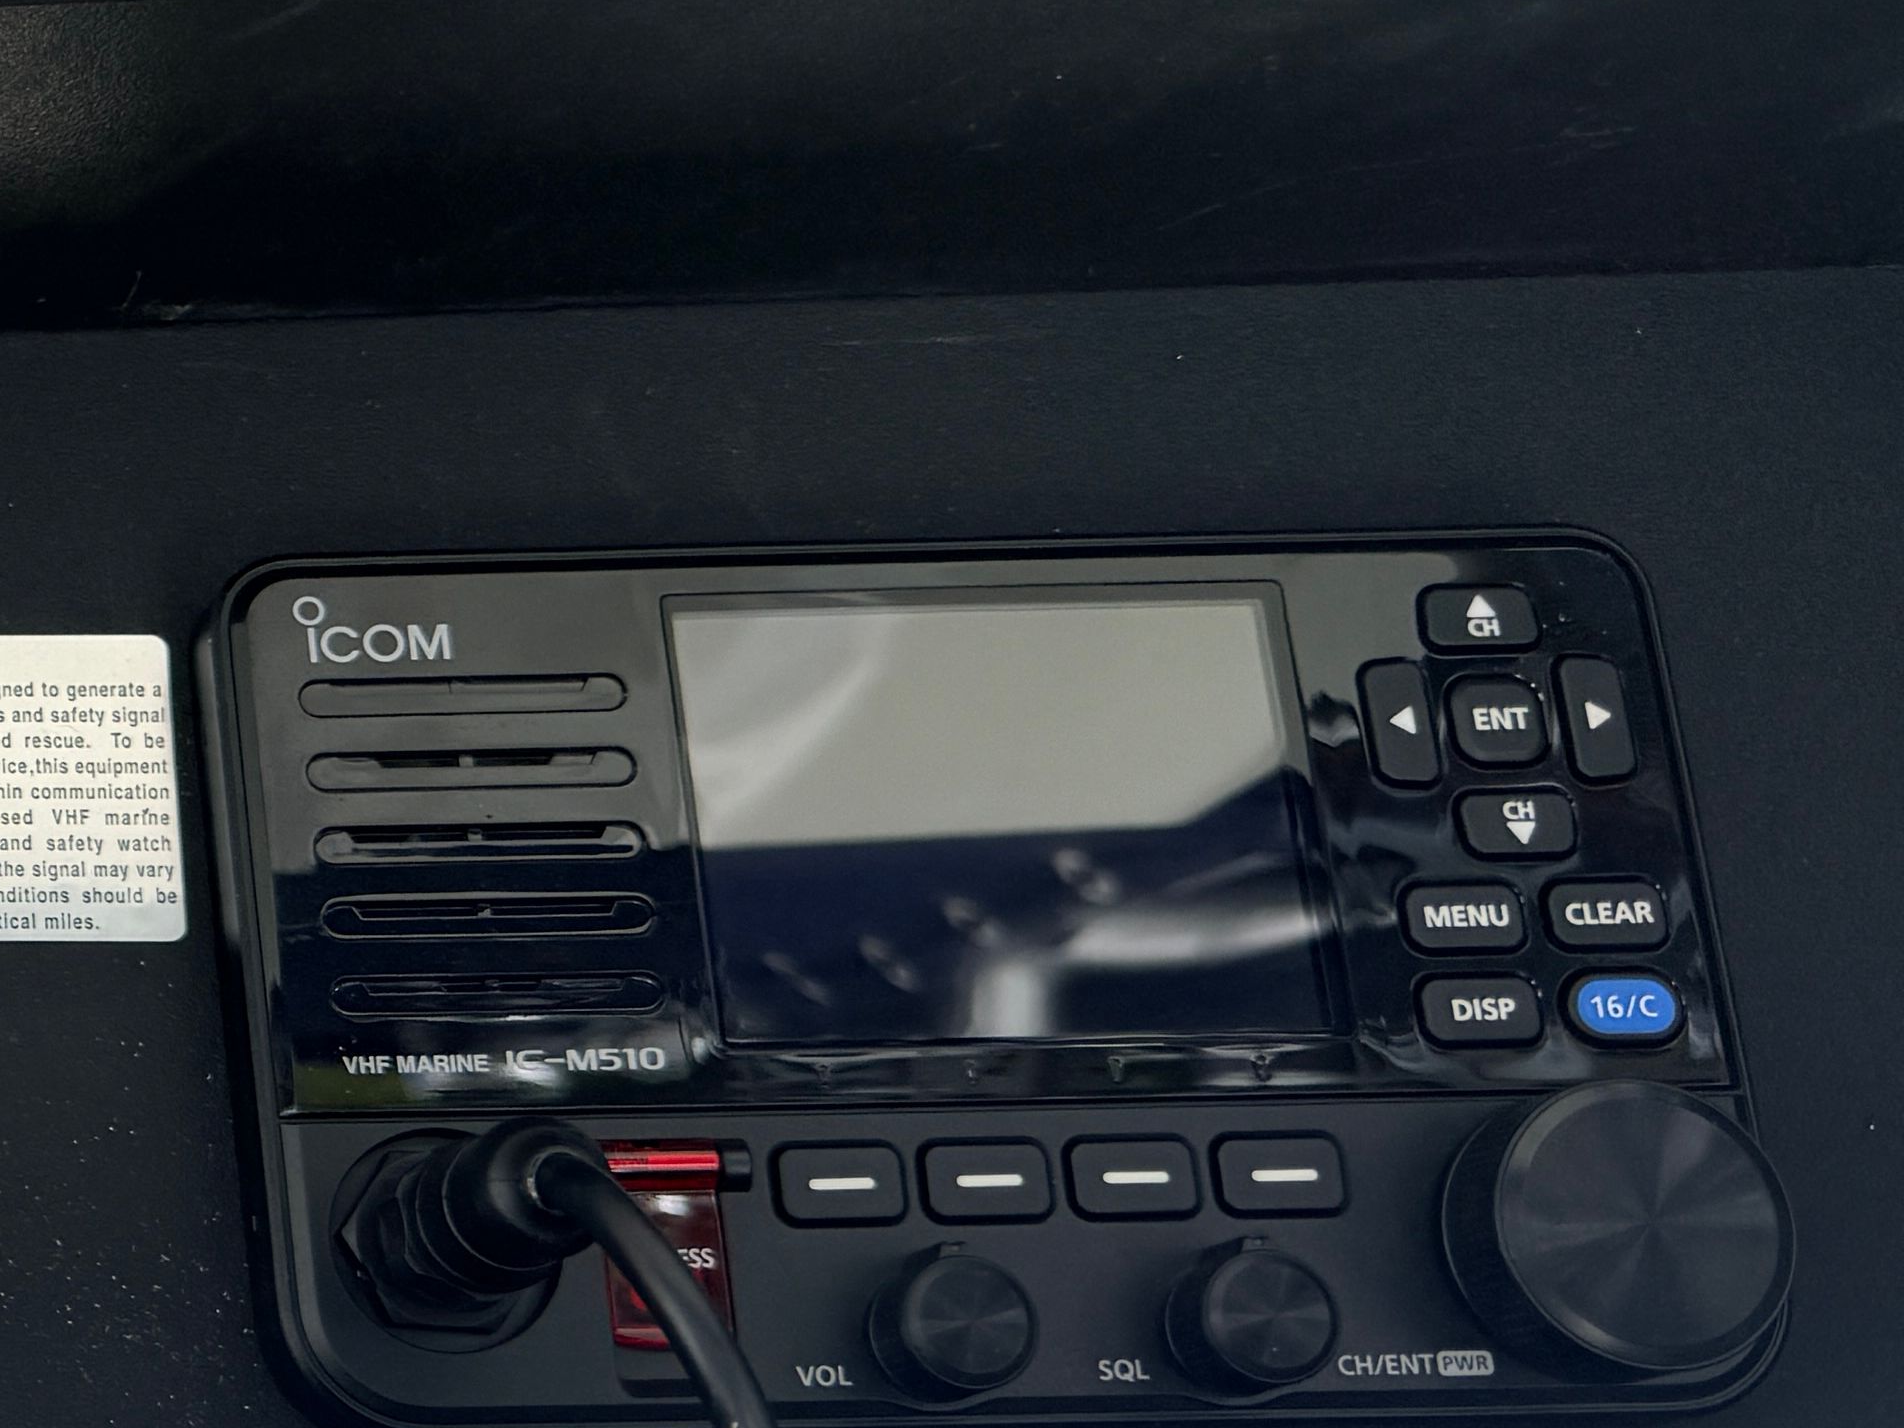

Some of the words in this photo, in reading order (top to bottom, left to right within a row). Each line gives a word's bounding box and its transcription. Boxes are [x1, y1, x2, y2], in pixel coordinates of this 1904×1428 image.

[1467, 618, 1501, 638] CH
[40, 681, 60, 698] to
[65, 681, 146, 703] generate
[152, 684, 163, 698] a
[11, 706, 45, 724] and
[50, 705, 106, 728] safety
[111, 705, 166, 728] signal
[1472, 706, 1529, 731] ENT
[24, 734, 92, 750] rescue.
[109, 731, 133, 750] To
[143, 731, 166, 750] be
[74, 757, 169, 779] equipment
[30, 782, 170, 801] communication
[51, 807, 91, 826] VHF
[104, 808, 171, 827] marine
[1502, 801, 1535, 820] CH
[0, 833, 33, 852] and
[45, 833, 104, 857] safety
[116, 834, 172, 853] watch
[31, 859, 87, 883] signal
[93, 863, 130, 883] may
[135, 864, 175, 883] vary
[81, 886, 144, 905] should
[155, 886, 178, 905] be
[43, 911, 101, 931] miles.
[1423, 904, 1510, 928] MENU
[1564, 902, 1654, 926] CLEAR
[1450, 998, 1516, 1021] DISP
[1590, 994, 1659, 1018] 16/C
[343, 1056, 392, 1074] VHF
[397, 1054, 490, 1073] MARINE
[506, 1046, 665, 1072] IC-M510
[1098, 1360, 1150, 1381] SQL
[1338, 1353, 1434, 1376] CH/ENT
[1443, 1355, 1489, 1371] PWR
[796, 1365, 853, 1387] VOL
